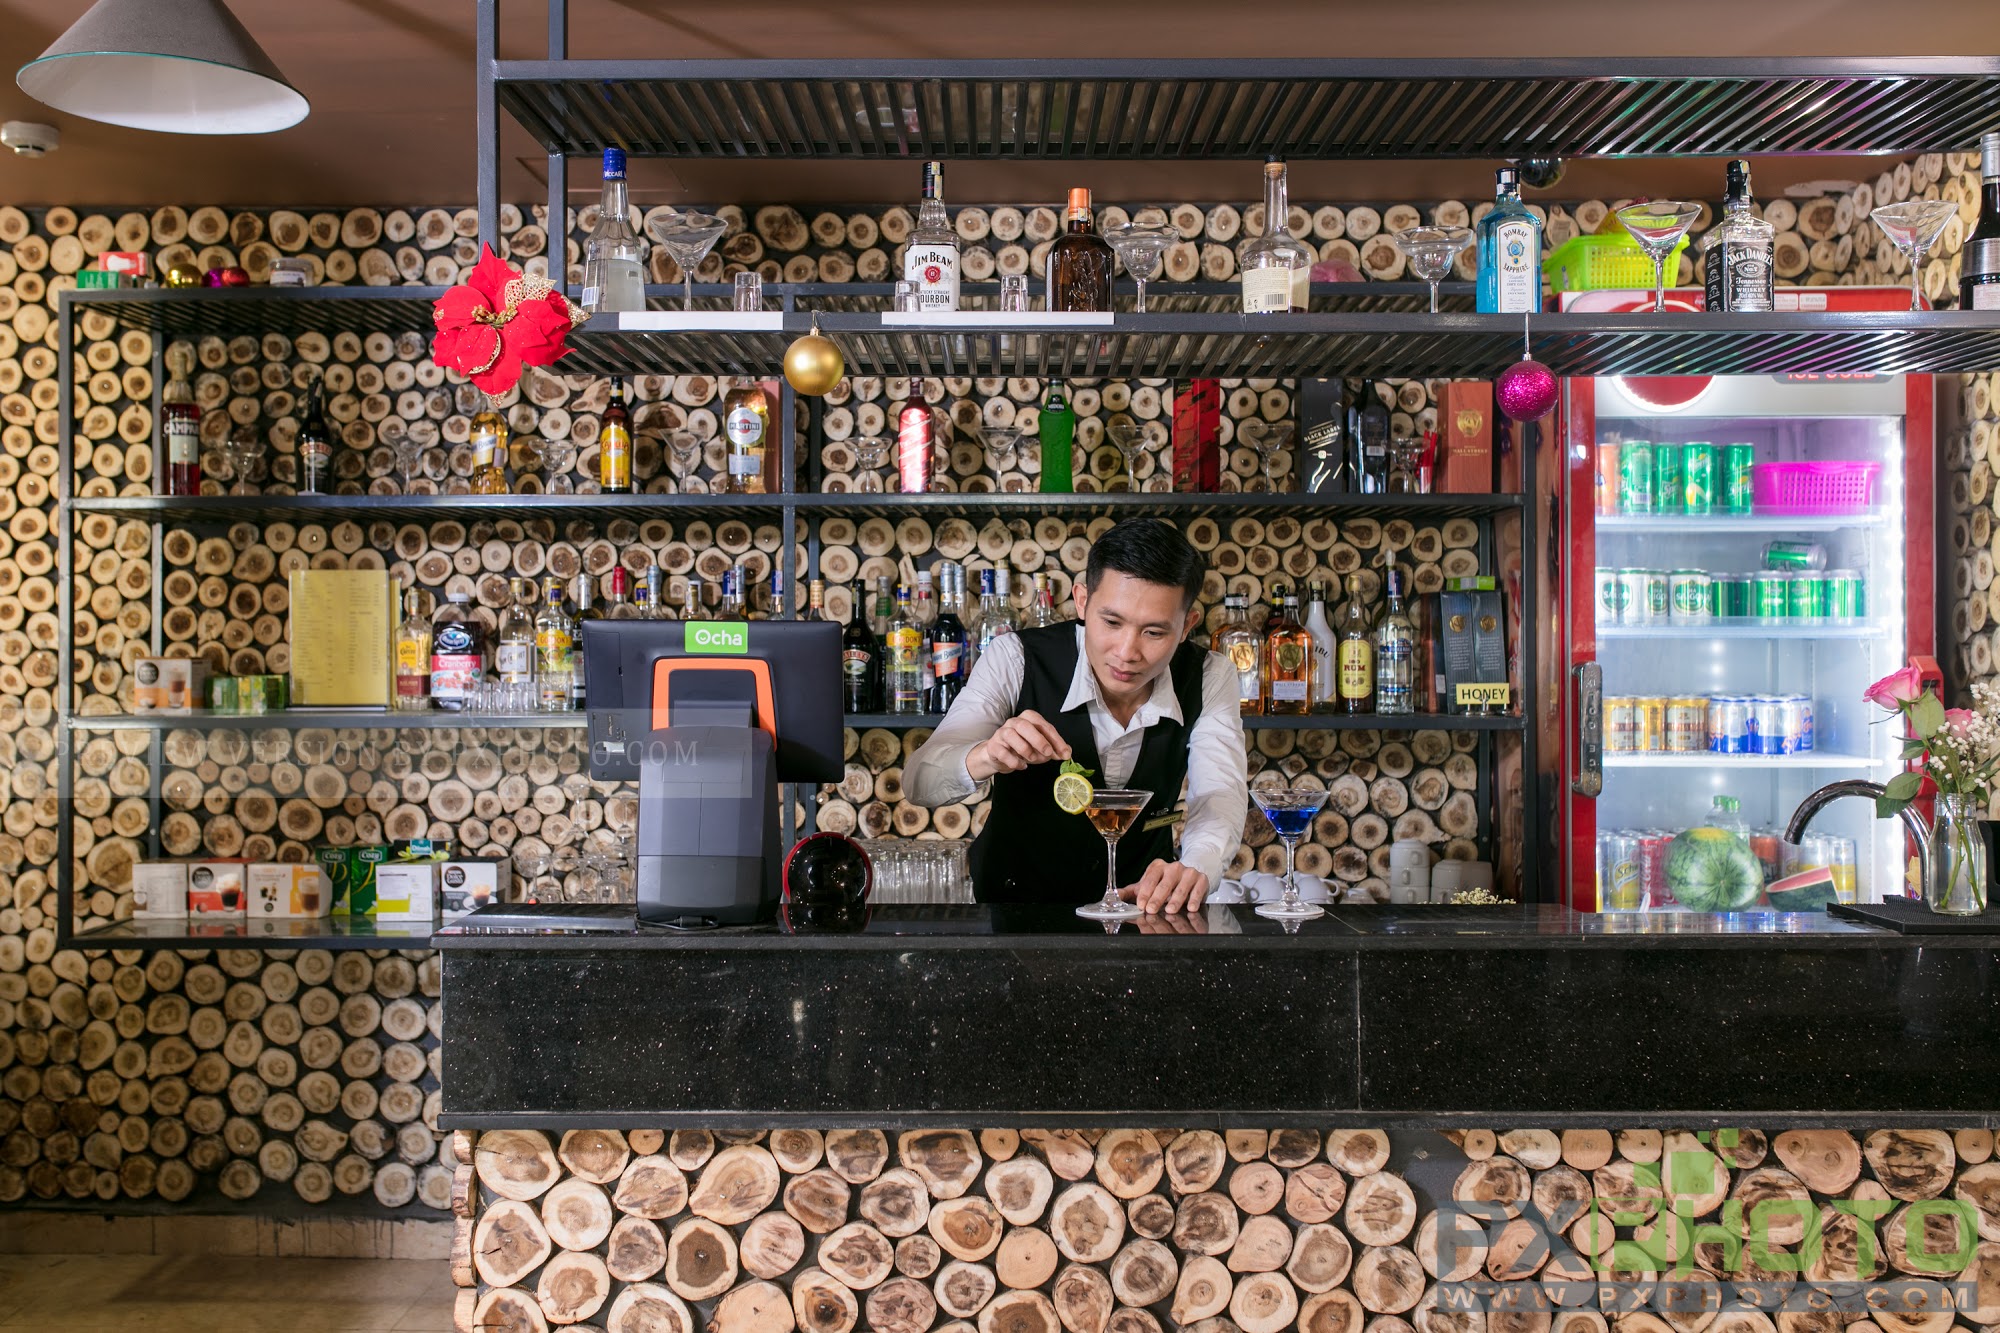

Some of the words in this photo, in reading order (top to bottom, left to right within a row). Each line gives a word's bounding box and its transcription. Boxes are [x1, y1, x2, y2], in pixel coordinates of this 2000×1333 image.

[1503, 228, 1529, 240] BOMBAY
[912, 254, 928, 271] JIM
[930, 251, 953, 270] BEAM
[1728, 250, 1746, 266] JACK
[1503, 263, 1531, 274] SAPPHIRE
[1735, 276, 1767, 285] Tennessee
[920, 295, 950, 303] OURBON
[729, 422, 760, 431] MARTINI
[695, 629, 742, 646] Ocha
[842, 650, 869, 661] AILEYS
[1313, 645, 1331, 659] IBU
[438, 660, 477, 669] Cranberry
[1461, 688, 1506, 700] HONEY
[360, 850, 380, 860] Cozy
